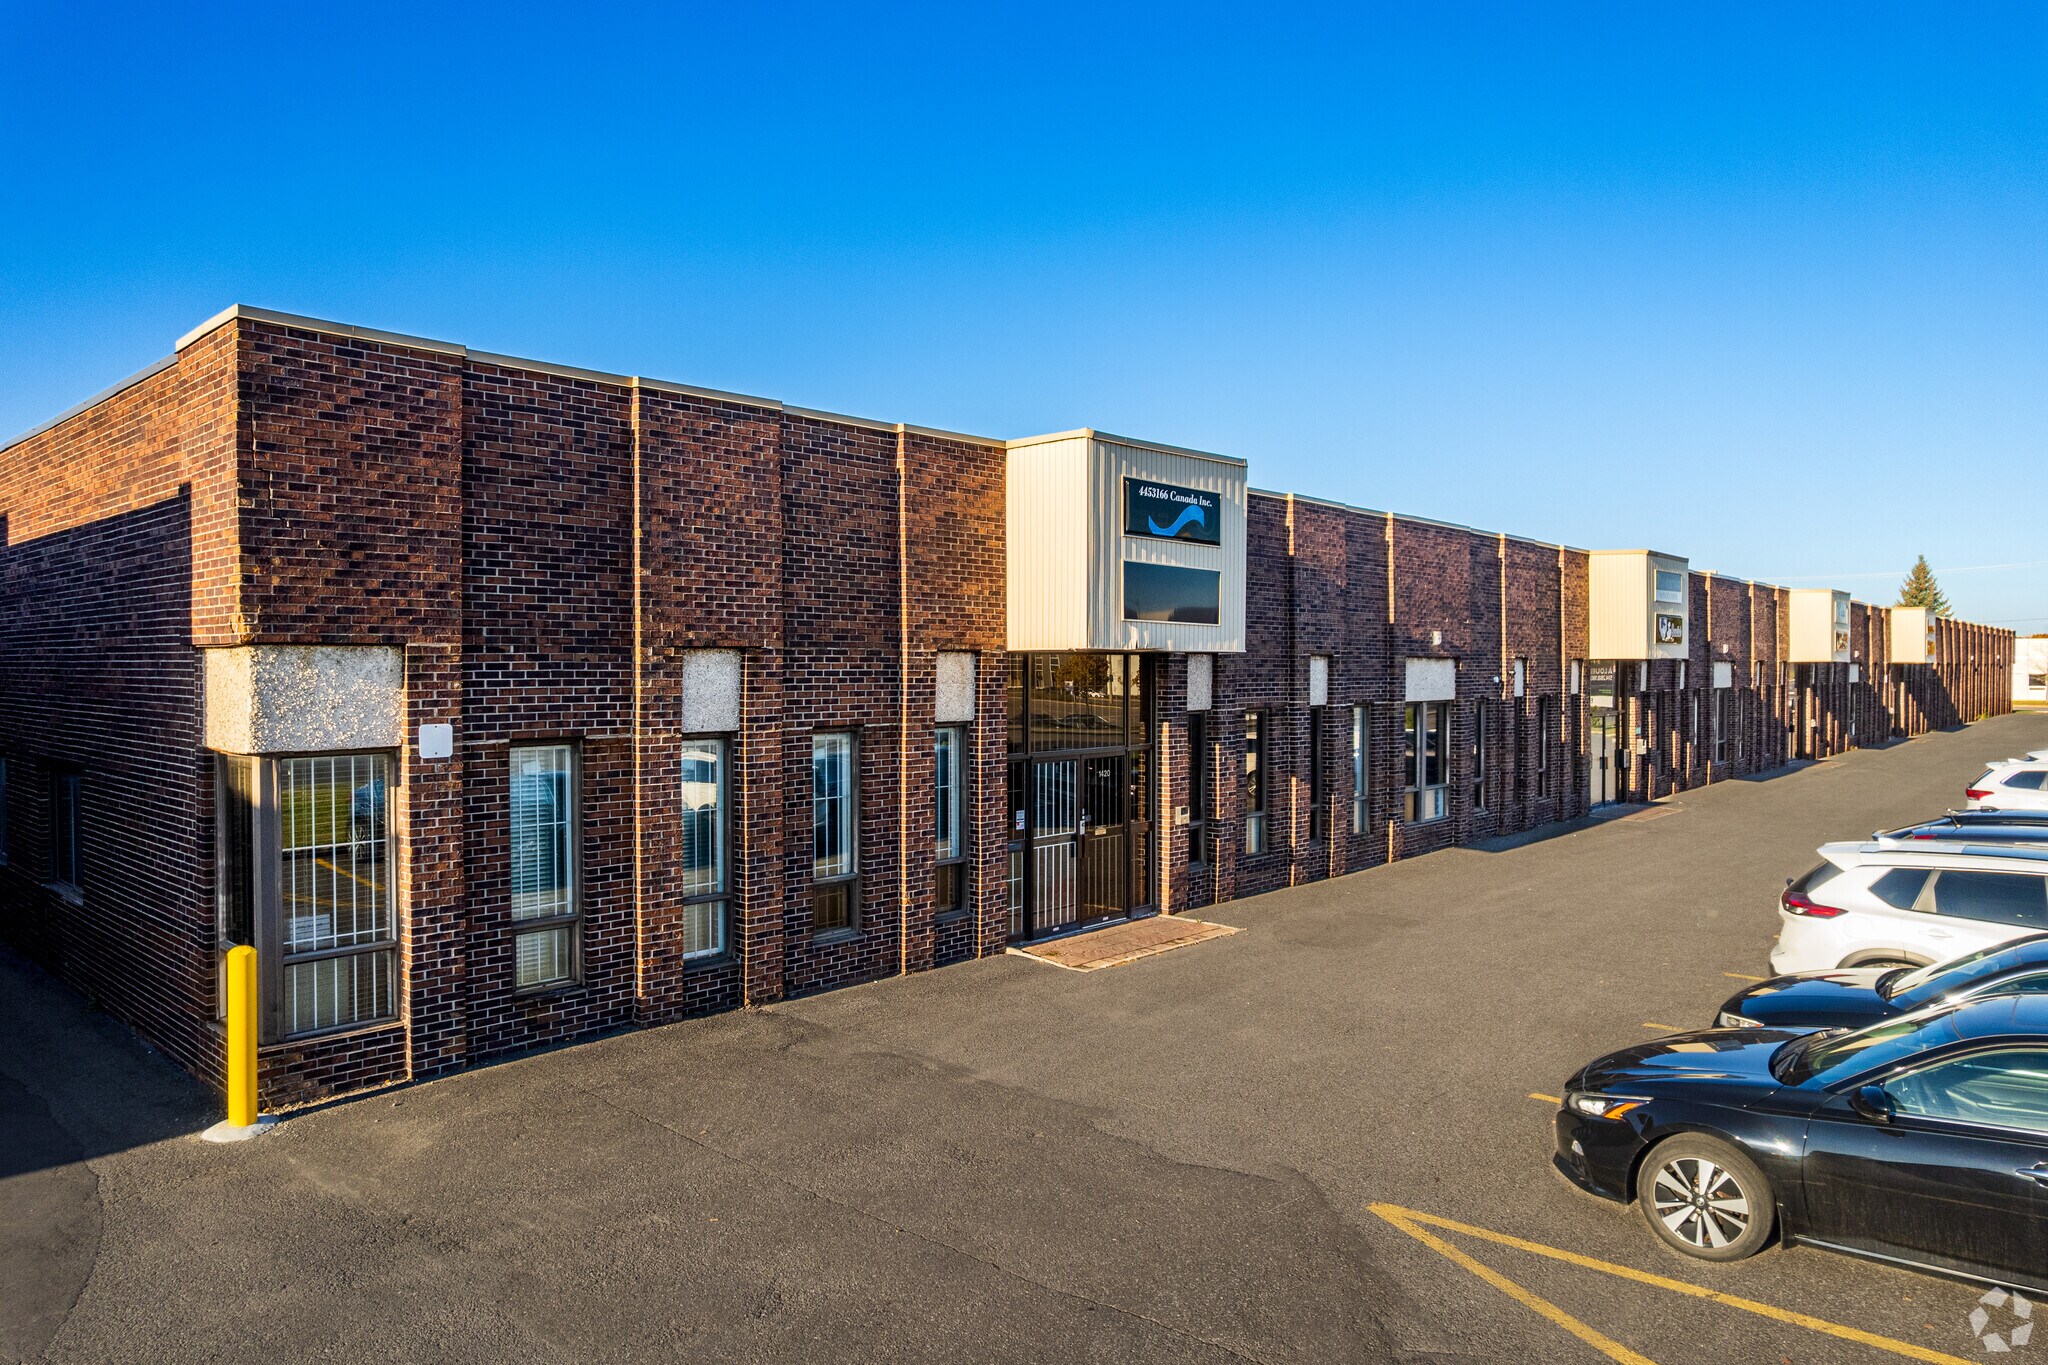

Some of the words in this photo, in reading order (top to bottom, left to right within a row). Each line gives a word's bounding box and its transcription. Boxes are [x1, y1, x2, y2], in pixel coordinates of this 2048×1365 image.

[1138, 485, 1169, 500] 4453166
[1170, 490, 1198, 505] Canada
[1199, 495, 1213, 507] Inc.
[1098, 769, 1111, 778] 1420
